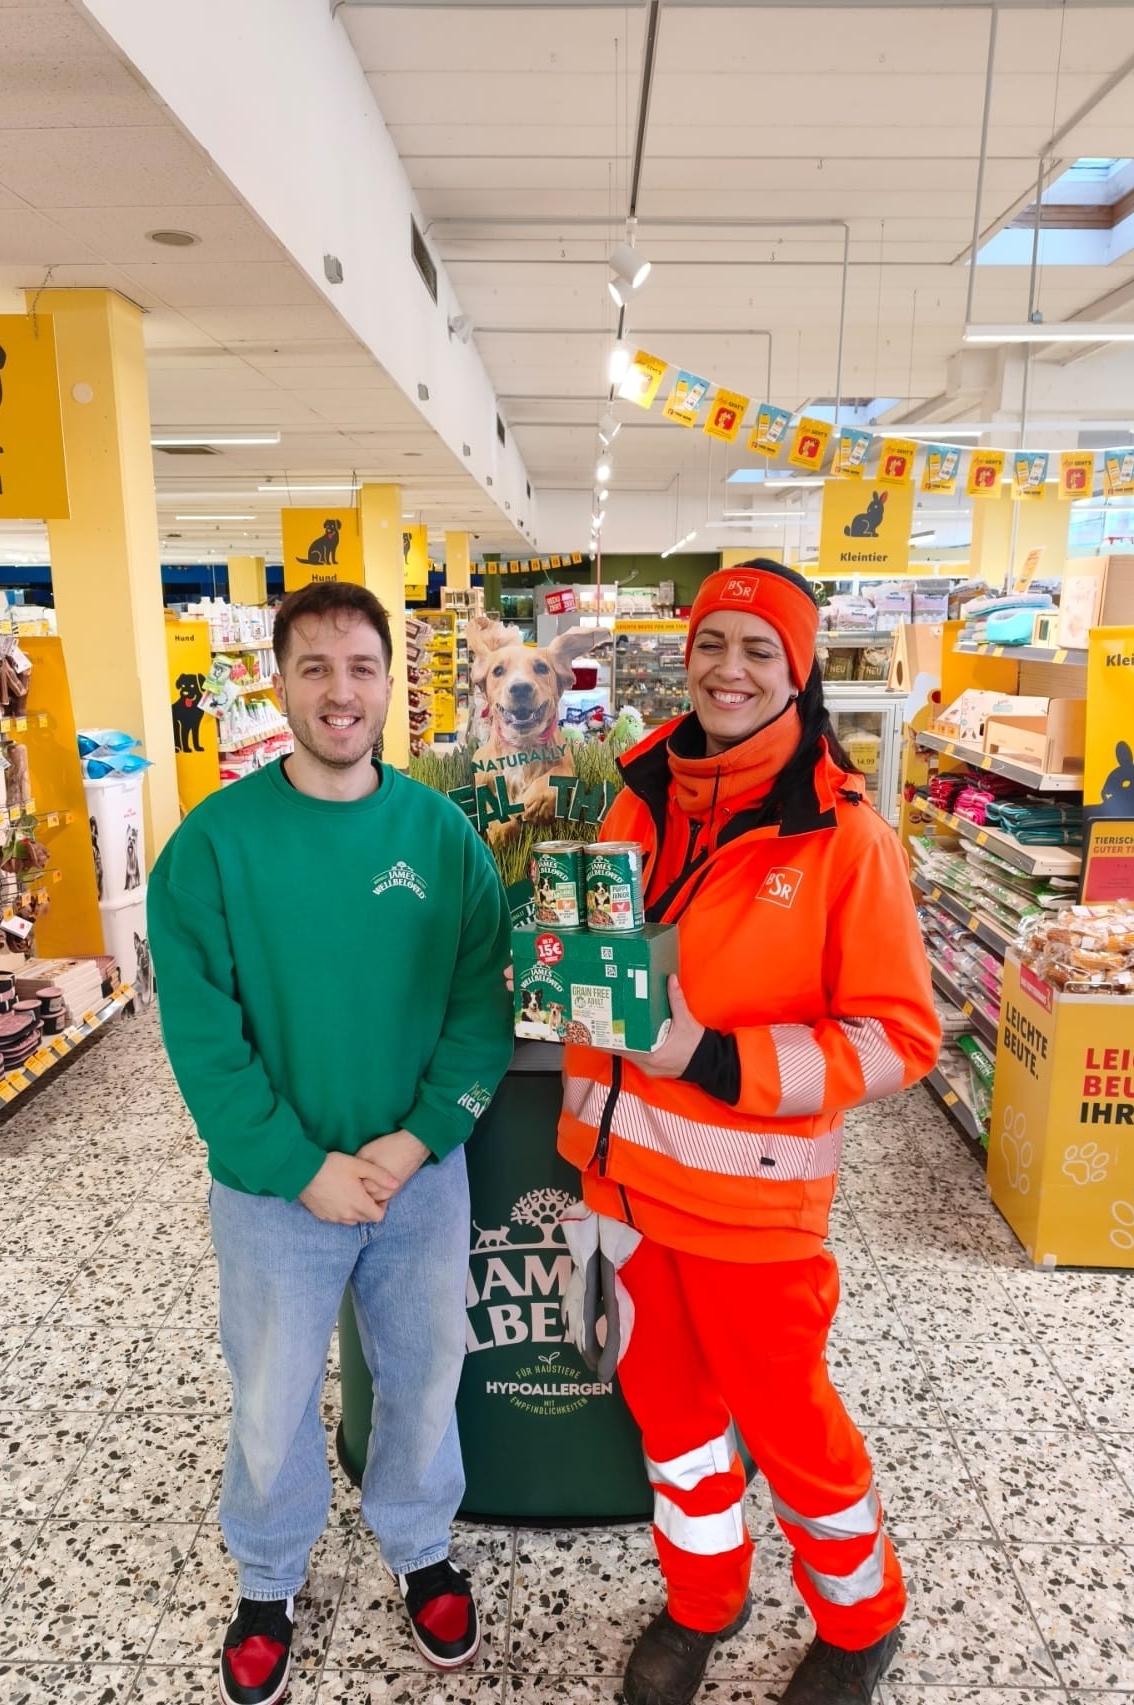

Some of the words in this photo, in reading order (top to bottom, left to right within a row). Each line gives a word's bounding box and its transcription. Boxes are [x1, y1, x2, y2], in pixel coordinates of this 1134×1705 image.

[840, 552, 888, 562] Kleintier
[311, 573, 338, 582] Hund
[728, 580, 752, 597] BSR
[174, 633, 195, 642] Hund
[1106, 653, 1134, 667] Klei
[829, 665, 846, 673] NEU
[865, 666, 880, 675] NEU
[471, 743, 567, 773] NATURALLY
[1093, 845, 1123, 854] GUTER
[388, 870, 415, 881] JAMES
[372, 878, 425, 899] WELLBELOVED
[765, 873, 792, 900] BSR
[538, 942, 562, 958] 15€
[531, 968, 552, 978] JAMES
[572, 986, 592, 997] GRAIN
[593, 988, 610, 999] FREE
[1006, 1001, 1048, 1060] LEICHTE
[1004, 1026, 1039, 1081] BEUTE.
[1085, 1047, 1134, 1071] LEI
[1080, 1102, 1134, 1125] IHR
[534, 1364, 581, 1380] HAUSTIERE
[486, 1381, 613, 1396] HYPOALLERGEN
[510, 1396, 588, 1416] EMPFINDLICHKEITEN
